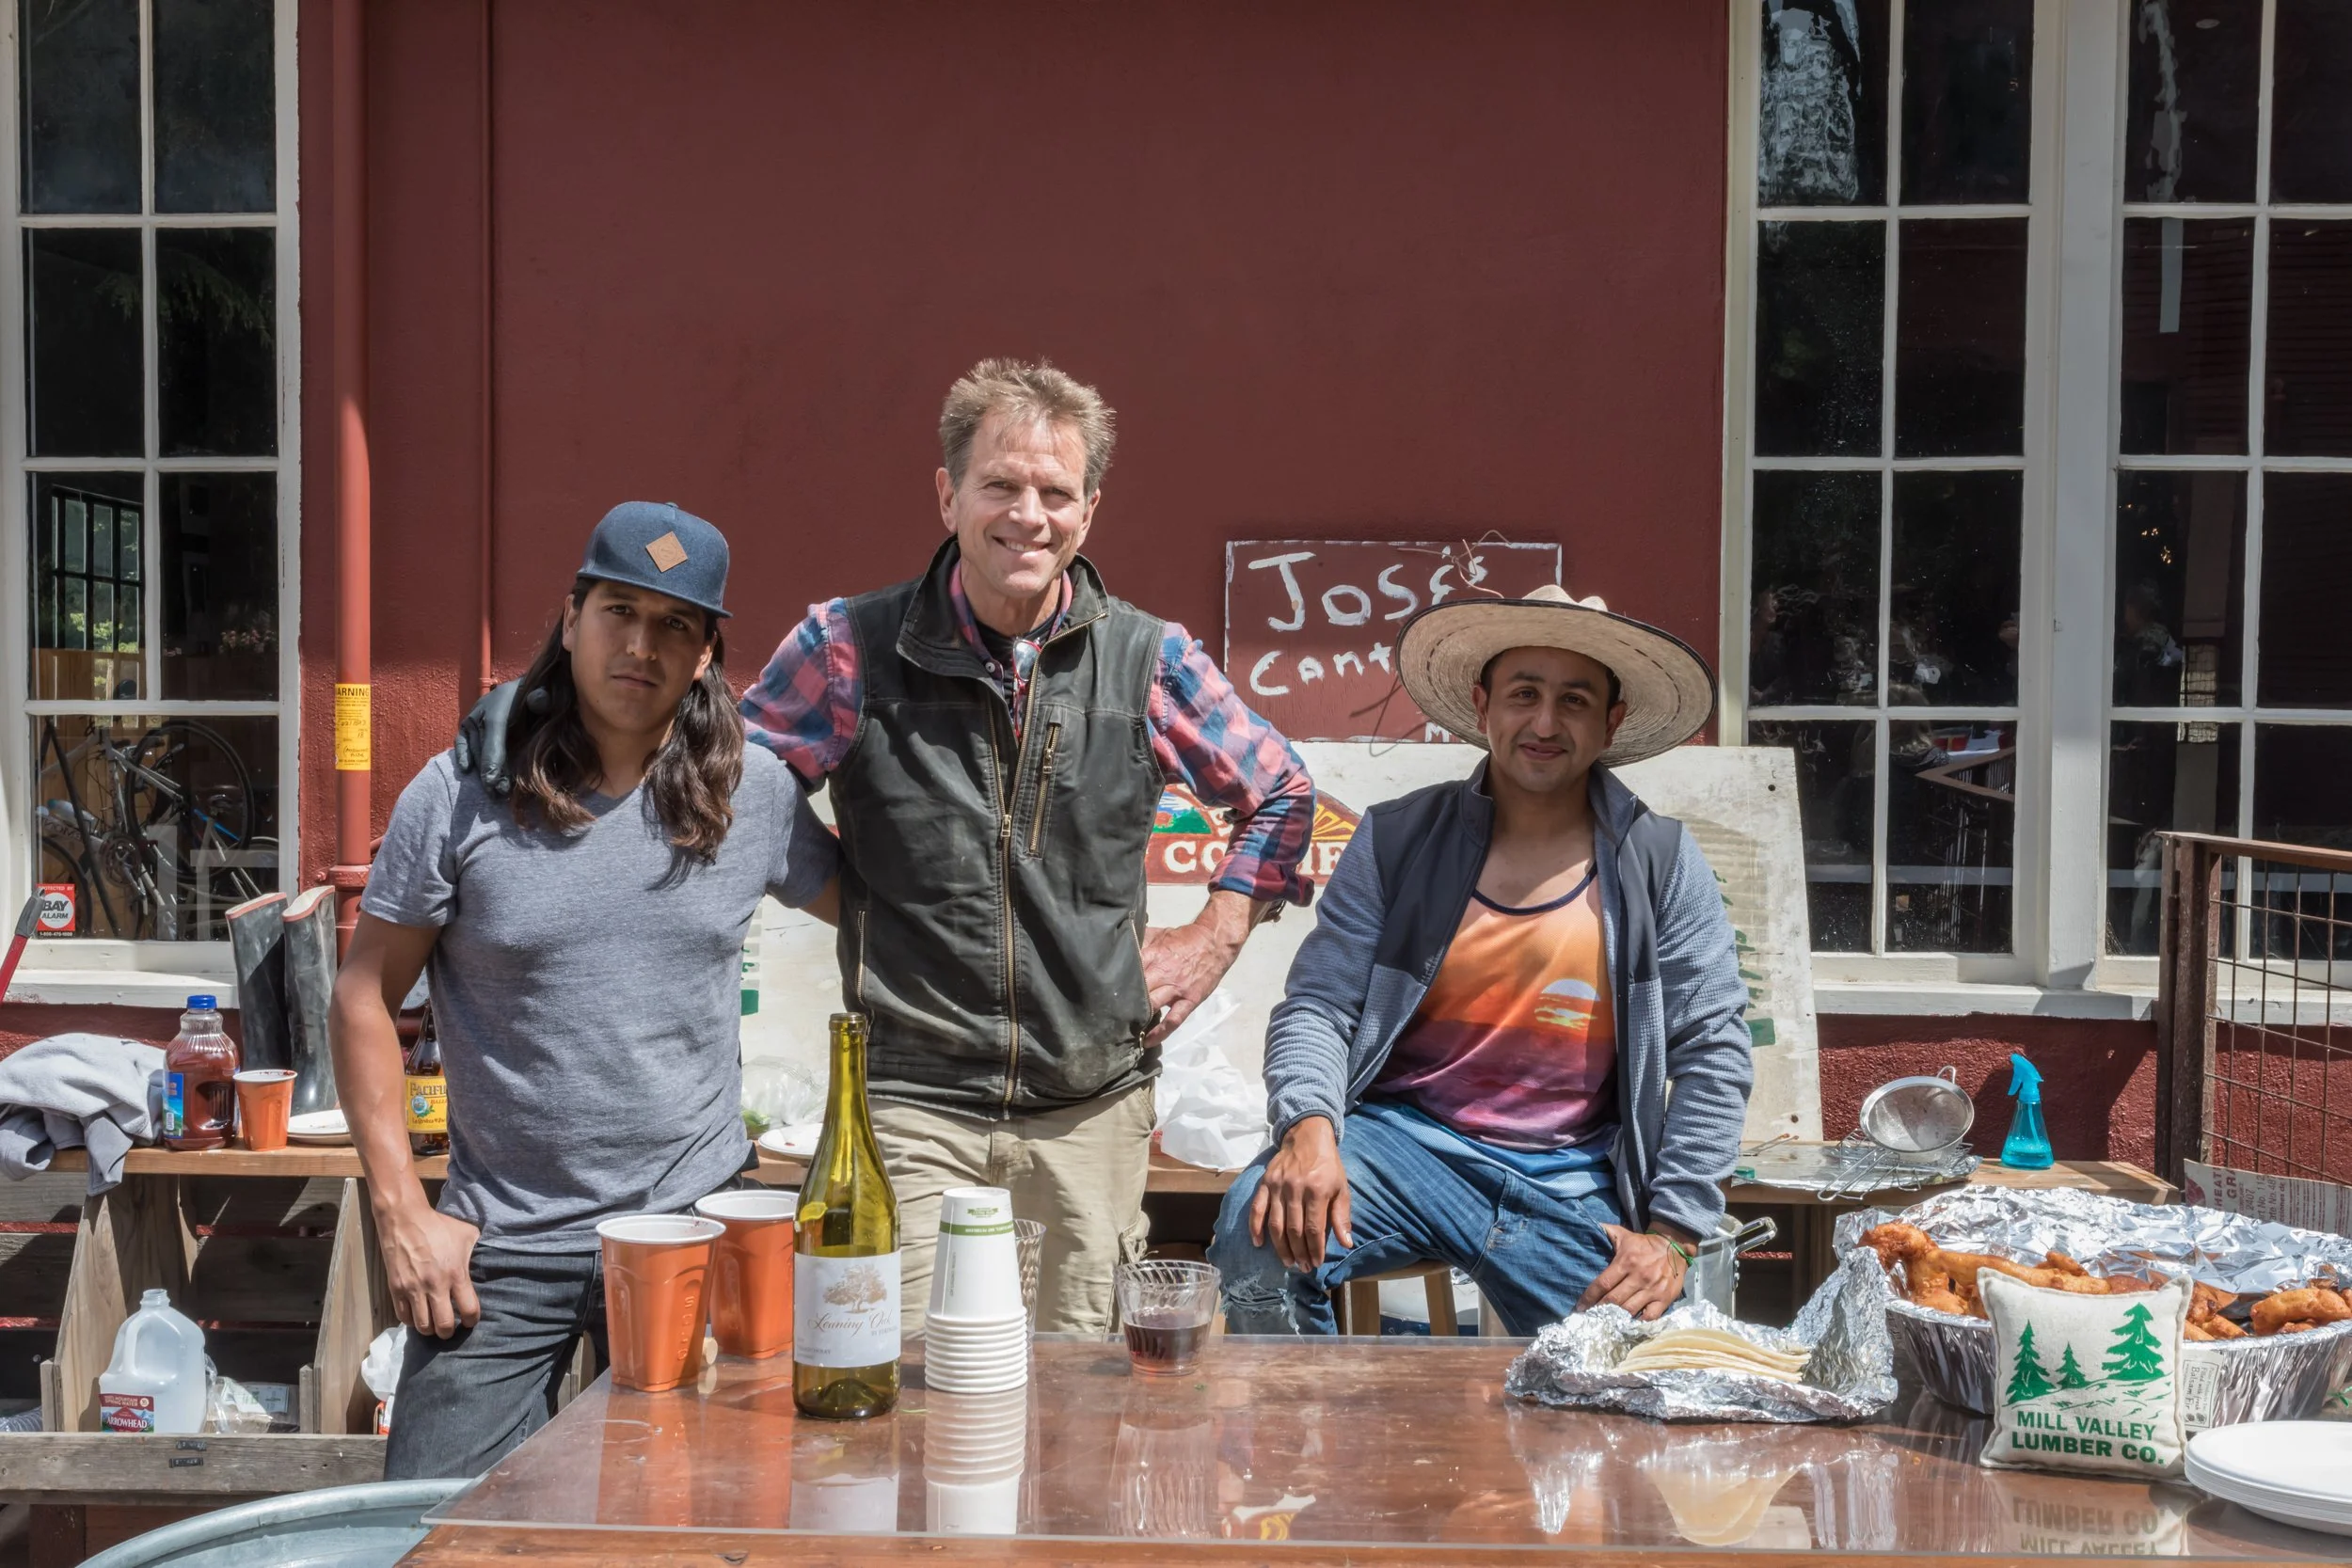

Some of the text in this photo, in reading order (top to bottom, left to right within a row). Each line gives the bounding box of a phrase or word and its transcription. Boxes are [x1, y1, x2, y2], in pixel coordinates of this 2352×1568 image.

[1249, 642, 1392, 696] Cant
[337, 688, 369, 696] ARNING
[43, 900, 69, 911] BAY
[2186, 1367, 2201, 1395] Balsam
[2185, 1398, 2194, 1410] Fir
[107, 1416, 148, 1429] ARROWHEAD
[2017, 1410, 2157, 1441] MILL VALLEY
[2011, 1431, 2165, 1465] LUMBER CO.
